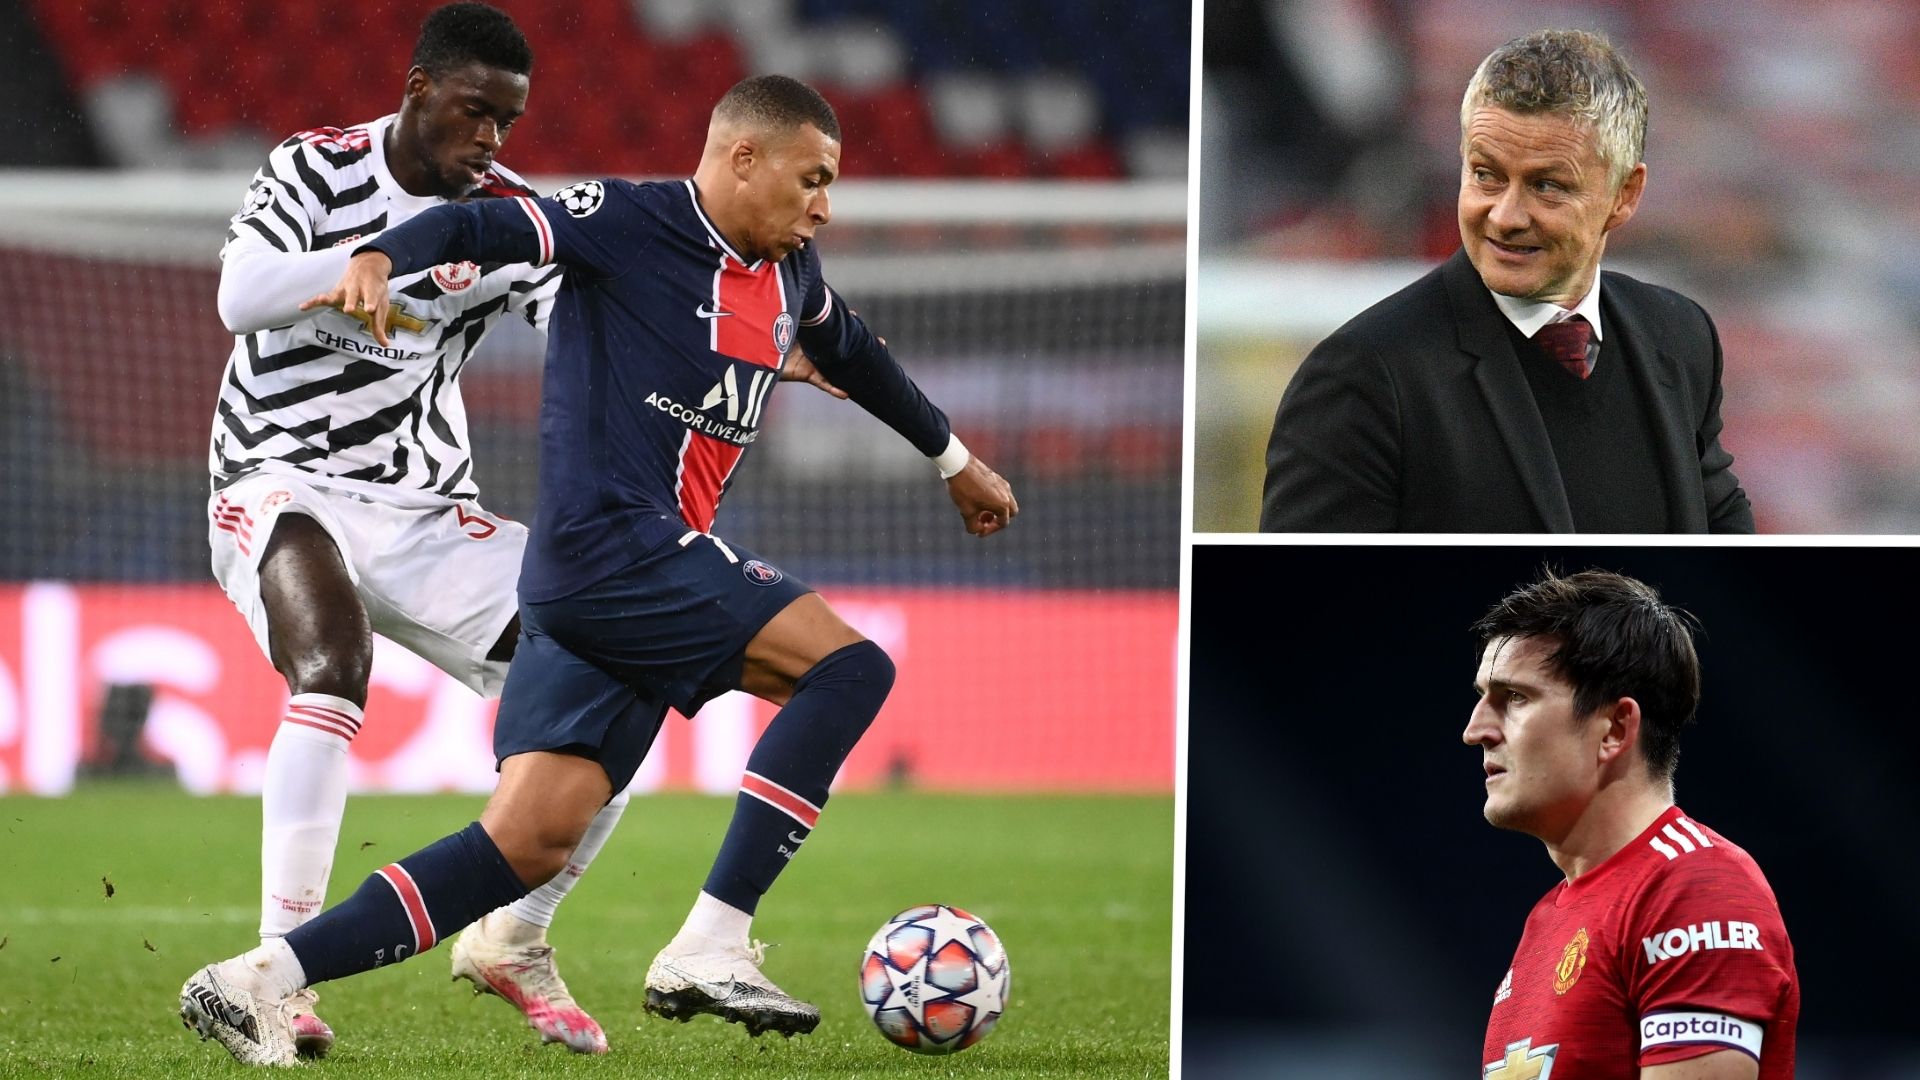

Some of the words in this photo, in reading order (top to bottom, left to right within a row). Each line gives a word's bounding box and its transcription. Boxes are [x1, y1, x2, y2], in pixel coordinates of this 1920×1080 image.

[644, 391, 705, 429] ACCOR
[704, 420, 736, 440] LIVE
[282, 904, 311, 913] UNITED
[1642, 920, 1764, 966] KOHLER
[1643, 1015, 1743, 1040] Captain
